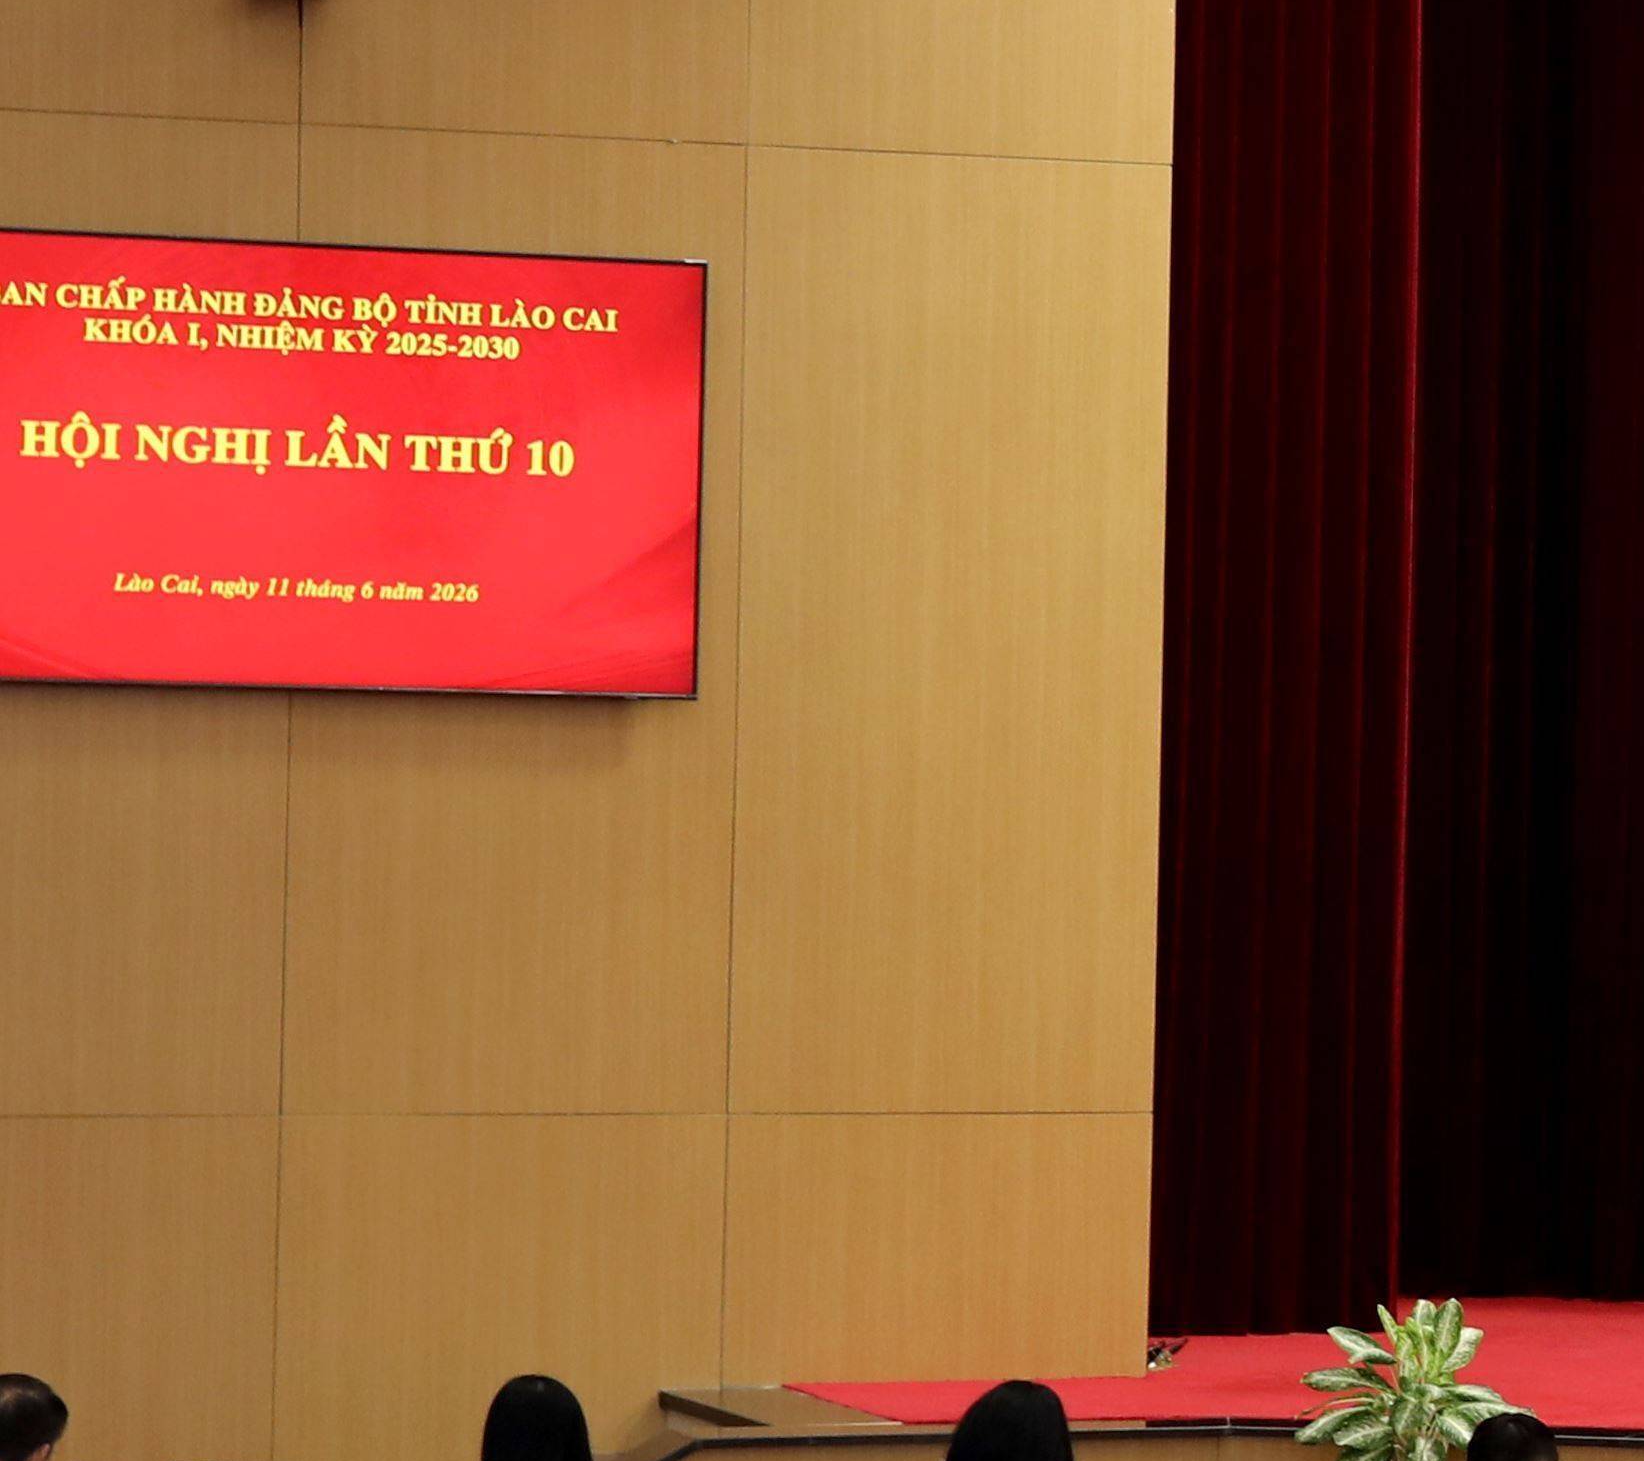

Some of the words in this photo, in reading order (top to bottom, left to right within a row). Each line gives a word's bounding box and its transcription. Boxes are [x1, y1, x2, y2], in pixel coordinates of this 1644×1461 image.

[0, 281, 48, 307] AN
[56, 276, 145, 310] CHẤP
[154, 284, 246, 315] HÀNH
[254, 288, 344, 320] ĐẢNG
[353, 293, 396, 327] BỘ
[405, 294, 482, 325] TỈNH
[490, 299, 555, 329] LÀO
[563, 308, 618, 331] CAI
[84, 314, 178, 344] KHÓA
[188, 323, 208, 350] I,
[217, 321, 324, 355] NHIỆM
[333, 324, 378, 353] KỲ
[386, 332, 519, 359] 2025-2030
[21, 412, 121, 468] HỘI
[135, 425, 271, 474] NGHỊ
[285, 415, 391, 469] LẦN
[405, 428, 512, 474] THỨ
[528, 441, 574, 476] 10
